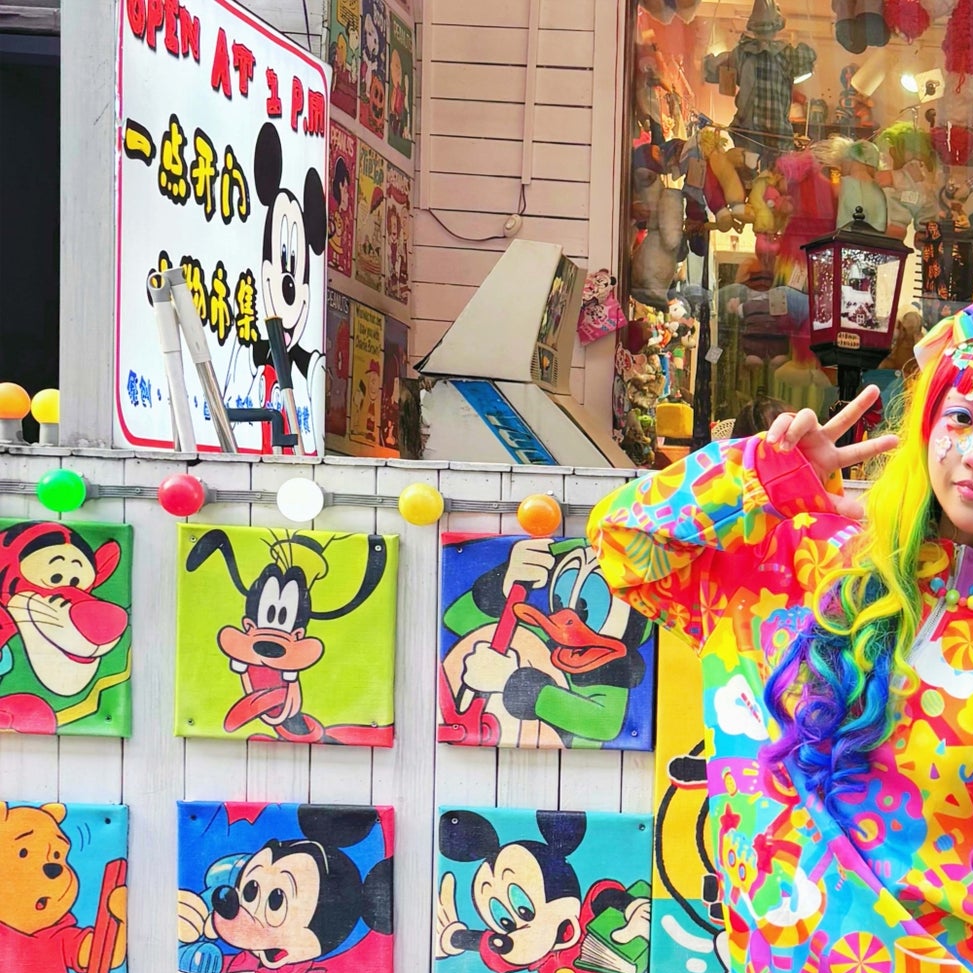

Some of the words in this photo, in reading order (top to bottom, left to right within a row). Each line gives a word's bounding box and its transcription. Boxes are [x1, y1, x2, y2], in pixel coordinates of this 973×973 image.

[127, 0, 200, 63] OPEN
[210, 27, 256, 100] AT
[265, 67, 282, 118] 1
[125, 113, 251, 225] 一点开门
[147, 250, 261, 348] 物市集
